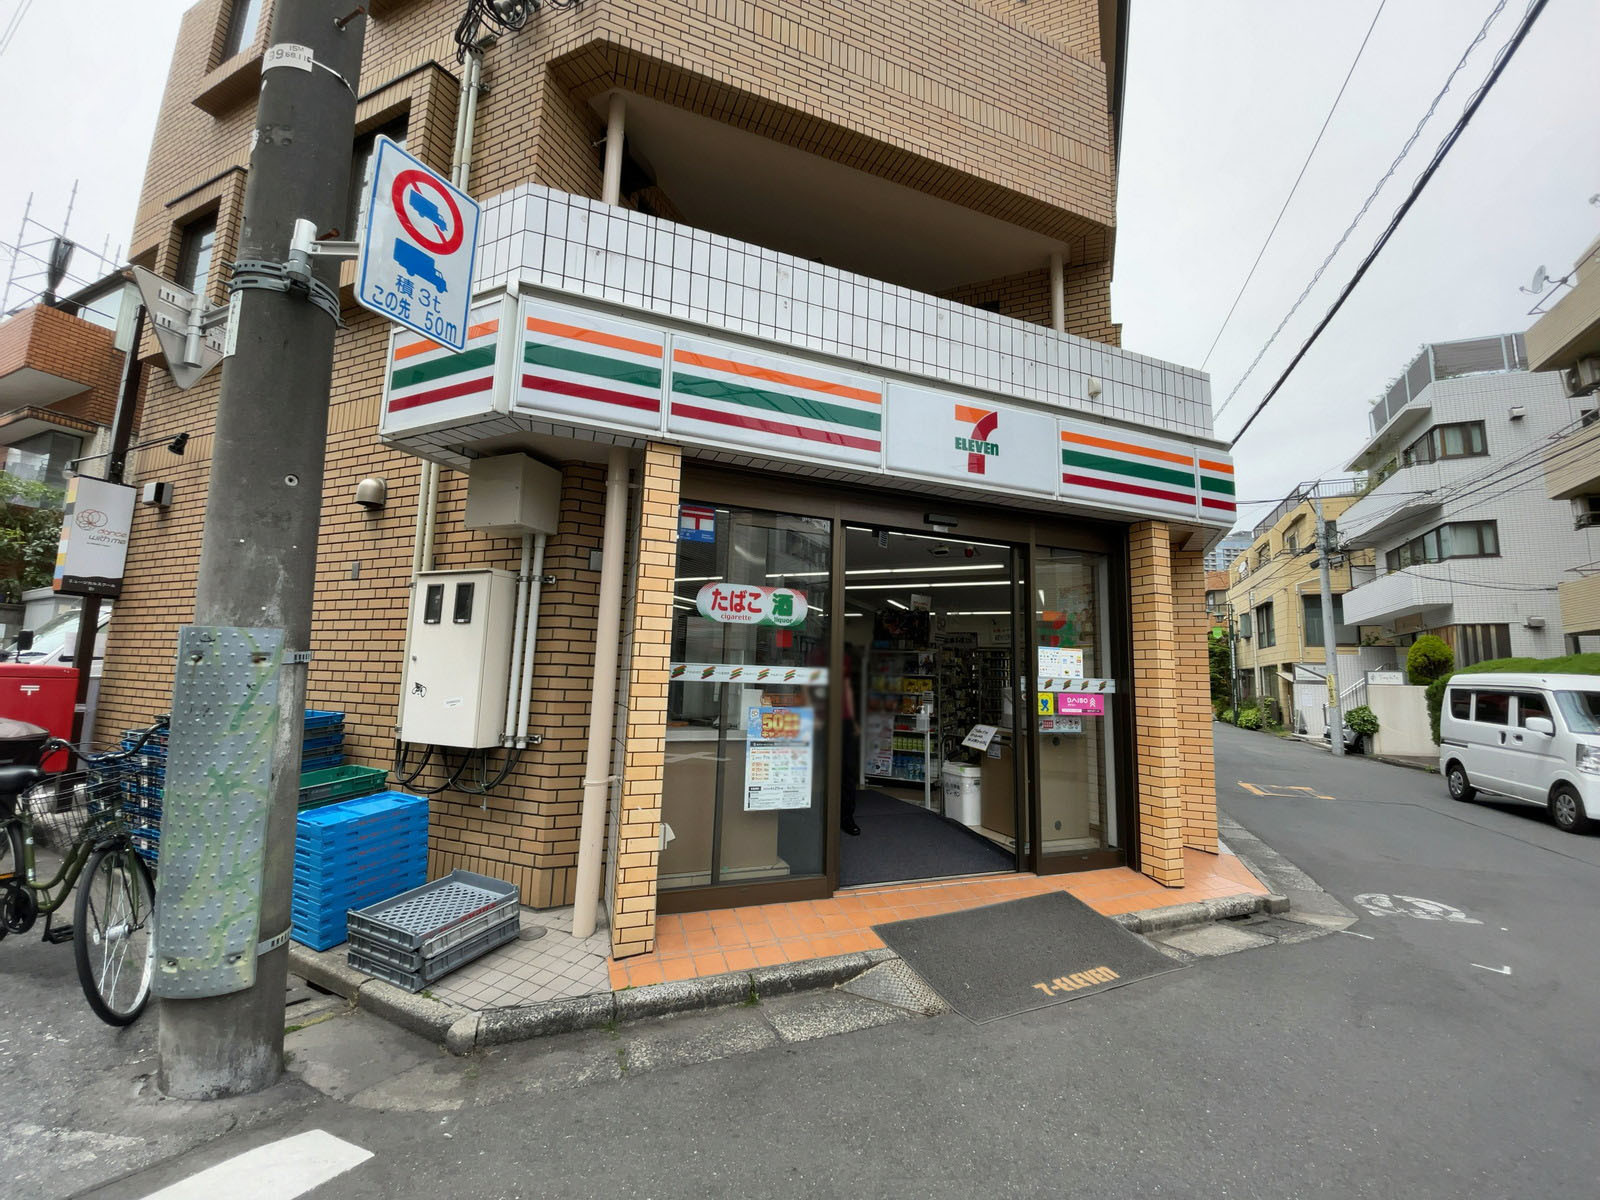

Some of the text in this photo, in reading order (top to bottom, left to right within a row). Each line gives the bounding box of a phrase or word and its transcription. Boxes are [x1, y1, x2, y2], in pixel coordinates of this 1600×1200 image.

[370, 284, 457, 344] この先 50m
[88, 534, 110, 543] with
[711, 588, 762, 614] たばこ
[772, 593, 794, 617] 酒
[720, 613, 752, 622] cigarette
[773, 616, 794, 625] liquor
